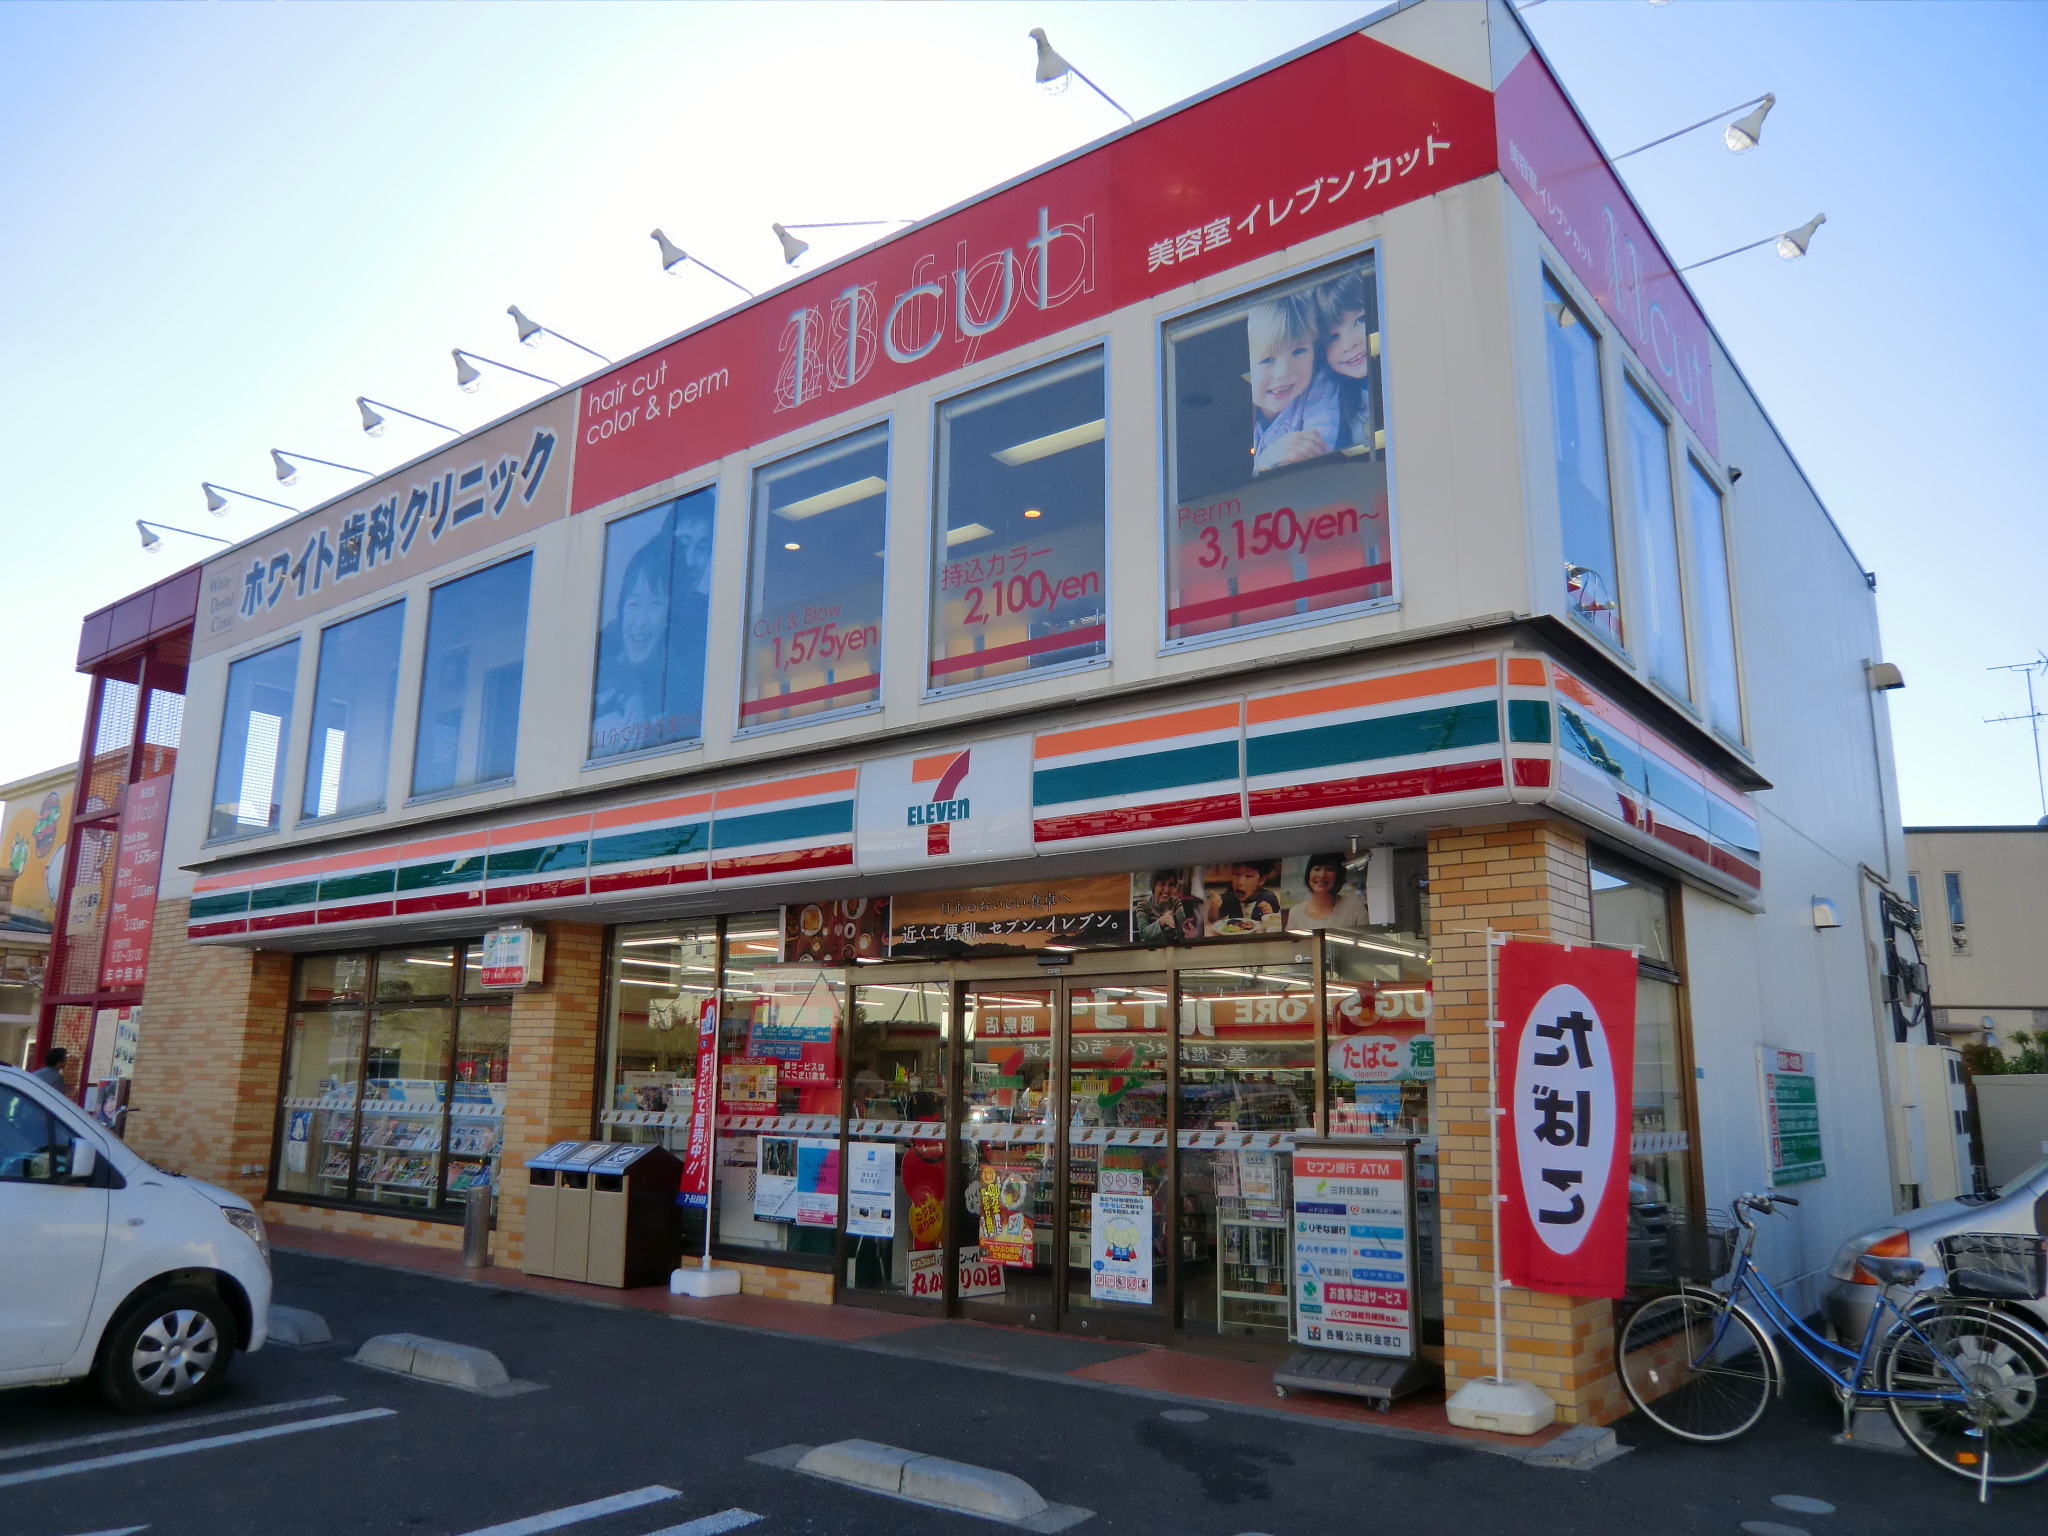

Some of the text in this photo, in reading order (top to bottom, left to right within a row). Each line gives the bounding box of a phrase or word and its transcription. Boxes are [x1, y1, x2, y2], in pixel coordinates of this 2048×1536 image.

[1147, 134, 1451, 272] 美容室 イレブン カット
[588, 360, 669, 418] hair cut
[586, 366, 730, 446] color & perm
[240, 428, 557, 617] ホワイト歯科クリニック
[1178, 498, 1242, 530] Perm
[941, 545, 1053, 592] 持込カラー
[210, 575, 232, 593] White
[963, 568, 1100, 627] 2,100yen
[753, 602, 844, 639] Cut & Blow
[772, 622, 878, 672] 1,575yen
[941, 891, 1071, 917] 日本のおいしい食卓へ
[105, 966, 144, 982] 年中無休
[1342, 1040, 1399, 1070] たばこ
[1409, 1040, 1435, 1068] 酒
[1354, 1069, 1388, 1079] cigarette
[1413, 1068, 1436, 1078] liquor
[1306, 1160, 1390, 1176] セブン銀行 ATM
[1330, 1186, 1379, 1197] 三井住友銀行
[1308, 1224, 1346, 1235] りそな銀行
[1305, 1245, 1347, 1256] 八千代銀行
[911, 1256, 936, 1270] 2月3日は
[1319, 1267, 1348, 1278] 新生銀行
[1329, 1287, 1402, 1306] お食事配達サービス
[1325, 1329, 1401, 1348] 各種公共料金窓口
